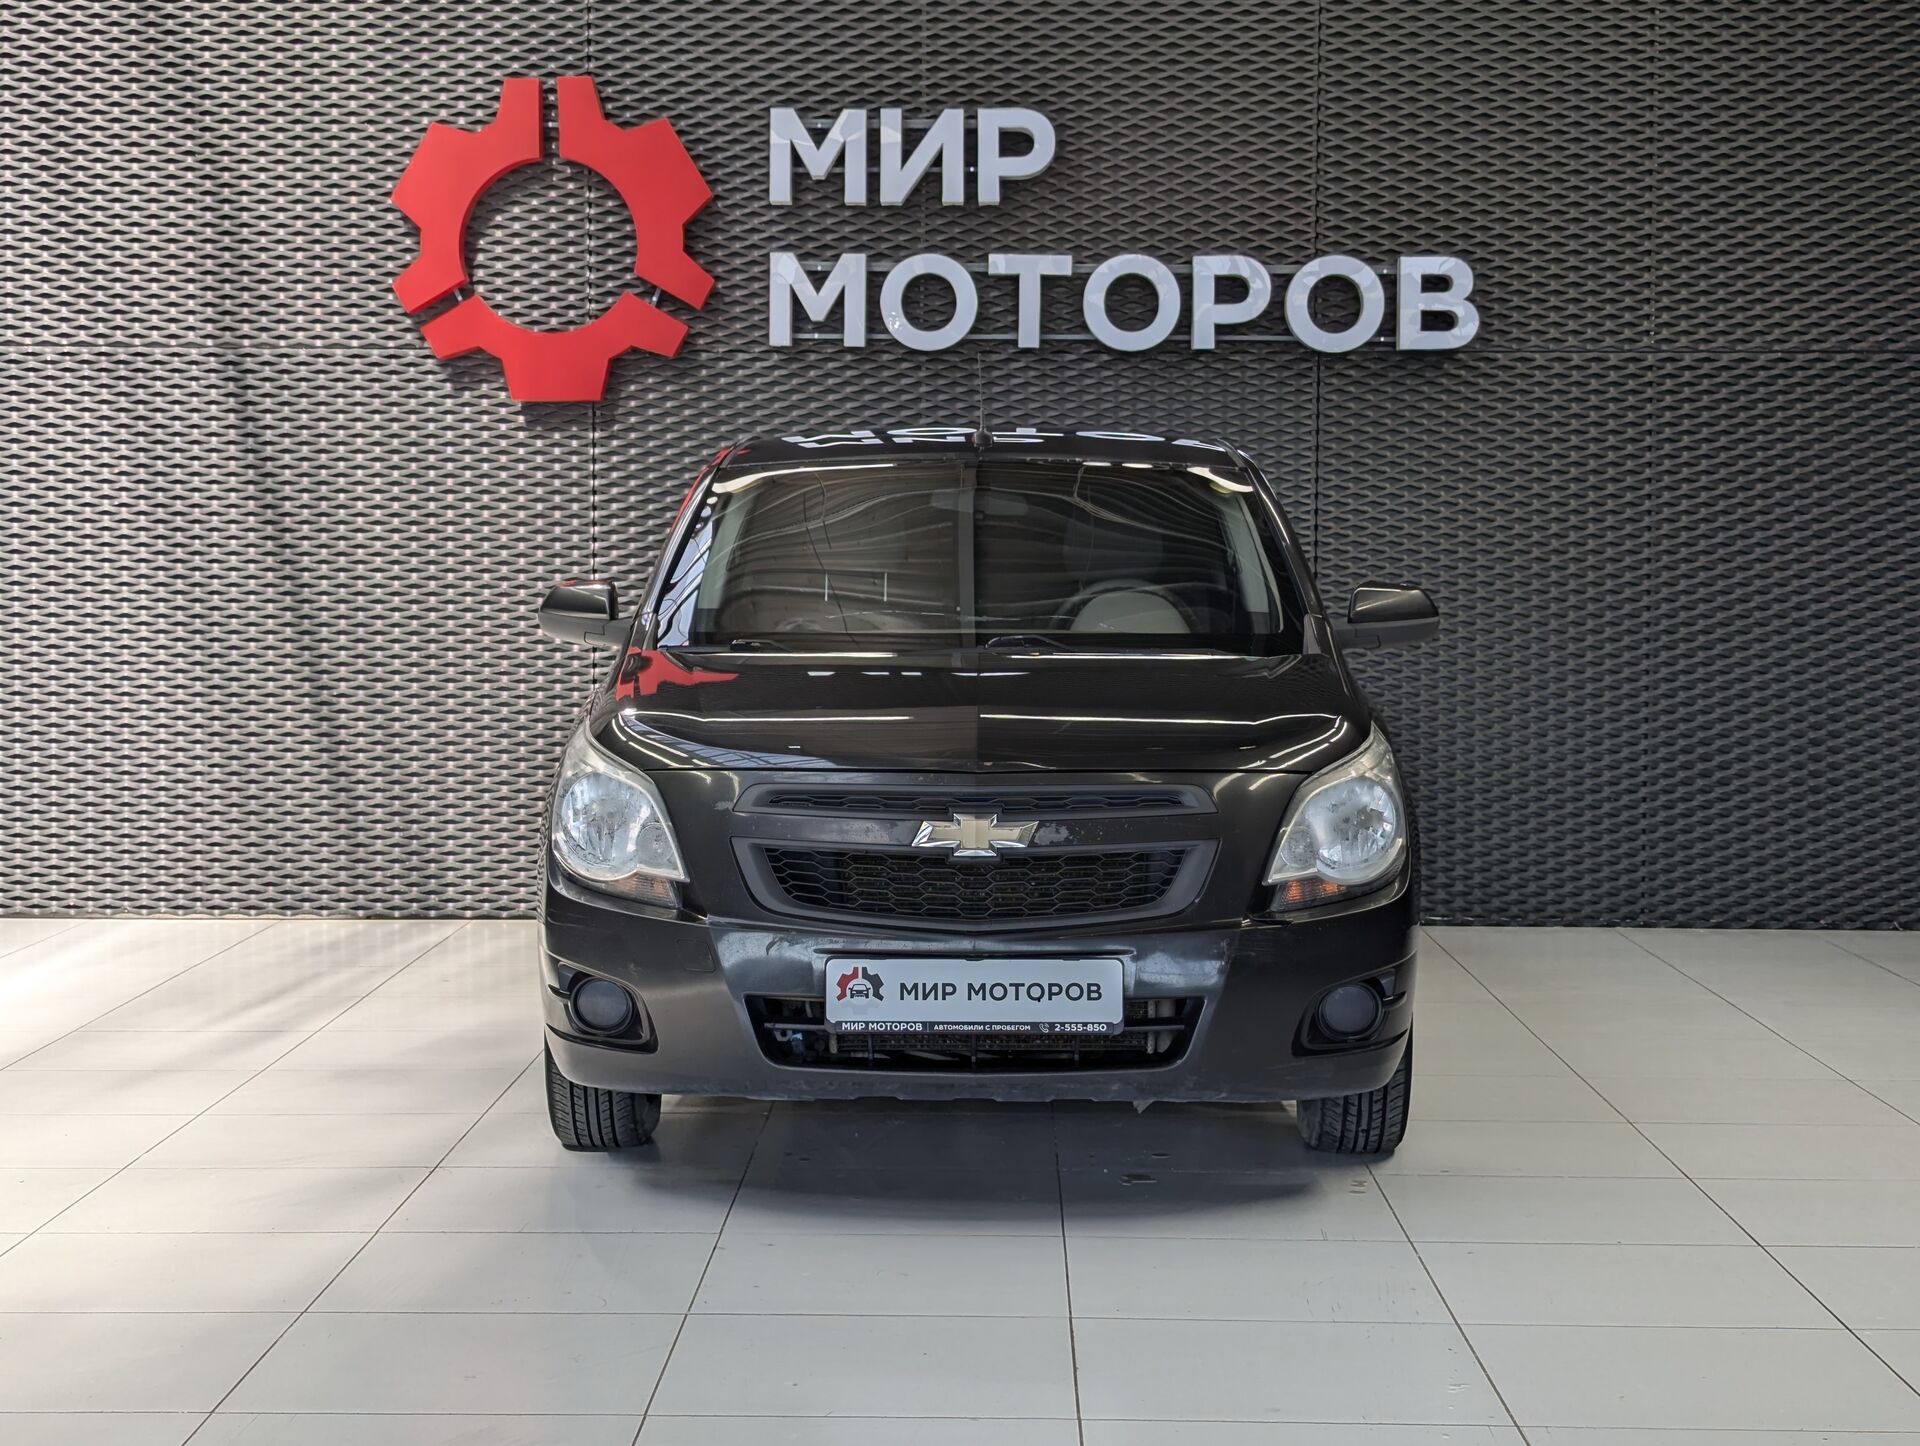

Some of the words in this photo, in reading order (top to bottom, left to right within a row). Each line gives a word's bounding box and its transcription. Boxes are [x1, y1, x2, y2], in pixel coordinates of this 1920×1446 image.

[769, 107, 1056, 206] МИР
[769, 252, 1480, 353] МОТОРОВ
[900, 982, 957, 1001] МИР
[967, 982, 1103, 1002] МОТОРОВ
[841, 1022, 865, 1031] МИР
[868, 1022, 923, 1032] МОТОРОВ
[933, 1024, 984, 1032] АВТОМОБИЛИ
[993, 1024, 1031, 1032] ПРОБЕГОМ
[1054, 1023, 1107, 1032] 2-555-850
